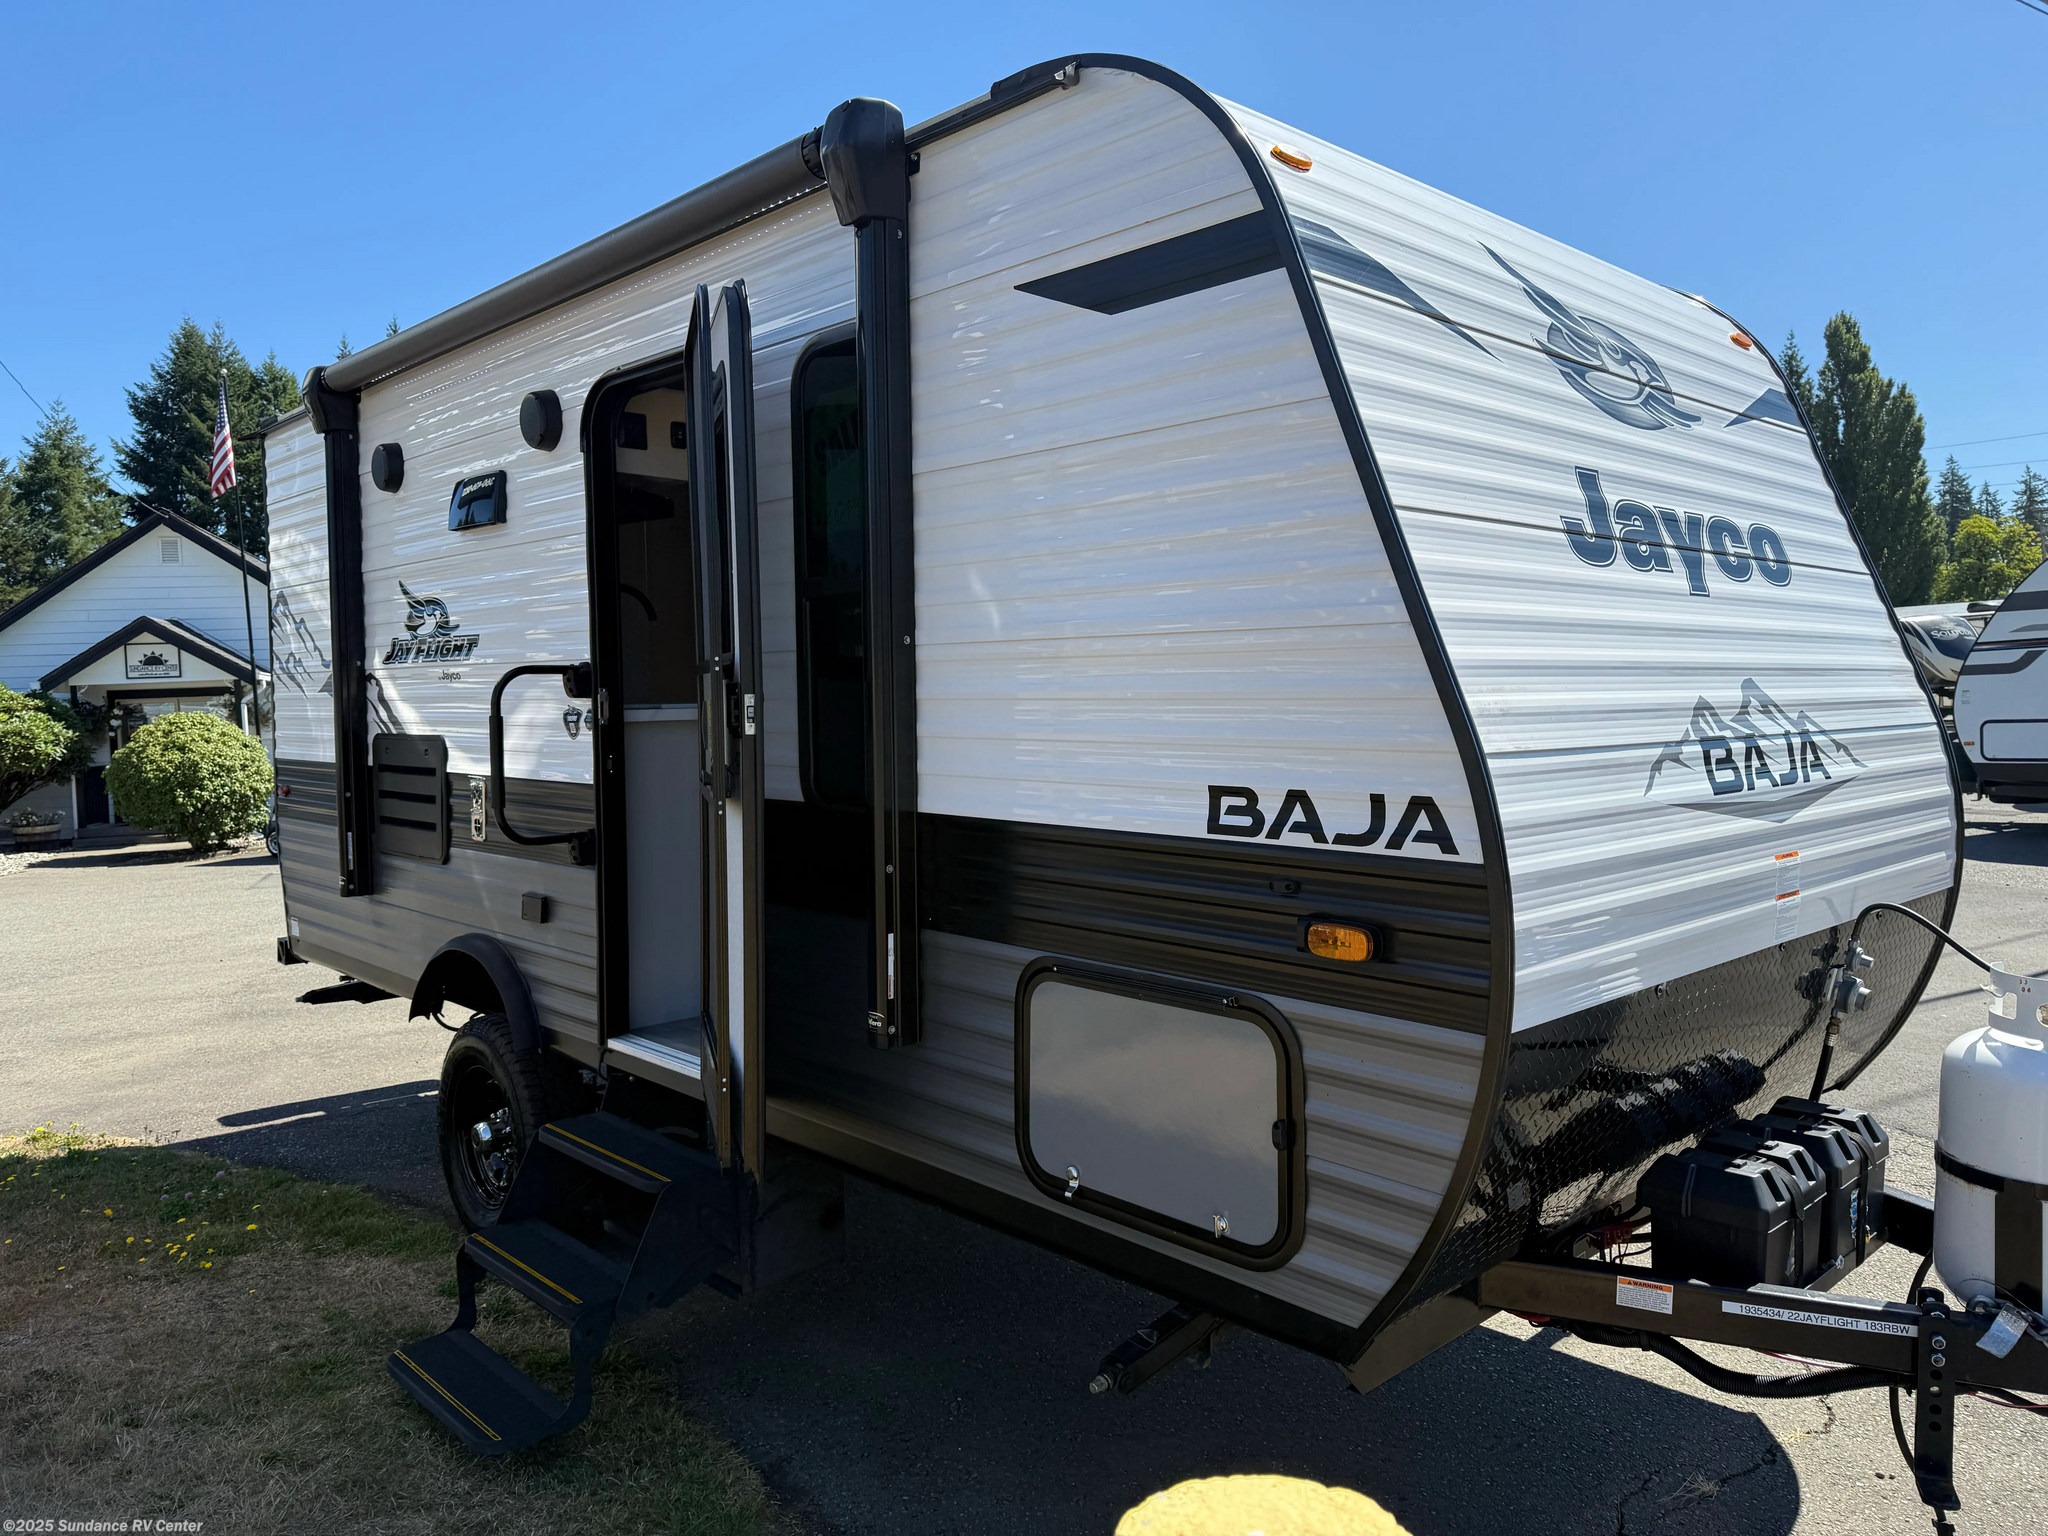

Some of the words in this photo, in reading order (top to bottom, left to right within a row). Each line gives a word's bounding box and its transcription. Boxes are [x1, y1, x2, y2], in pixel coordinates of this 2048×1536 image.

[1559, 465, 1793, 598] Jayco
[441, 670, 462, 682] Jayco
[1698, 729, 1832, 796] BAJA
[1206, 784, 1461, 856] BAJA
[1633, 1281, 1664, 1291] WARNING
[1739, 1304, 1785, 1319] 1935434/
[1787, 1312, 1862, 1329] 22JAYFLIGHT
[1864, 1321, 1911, 1335] 183RBW
